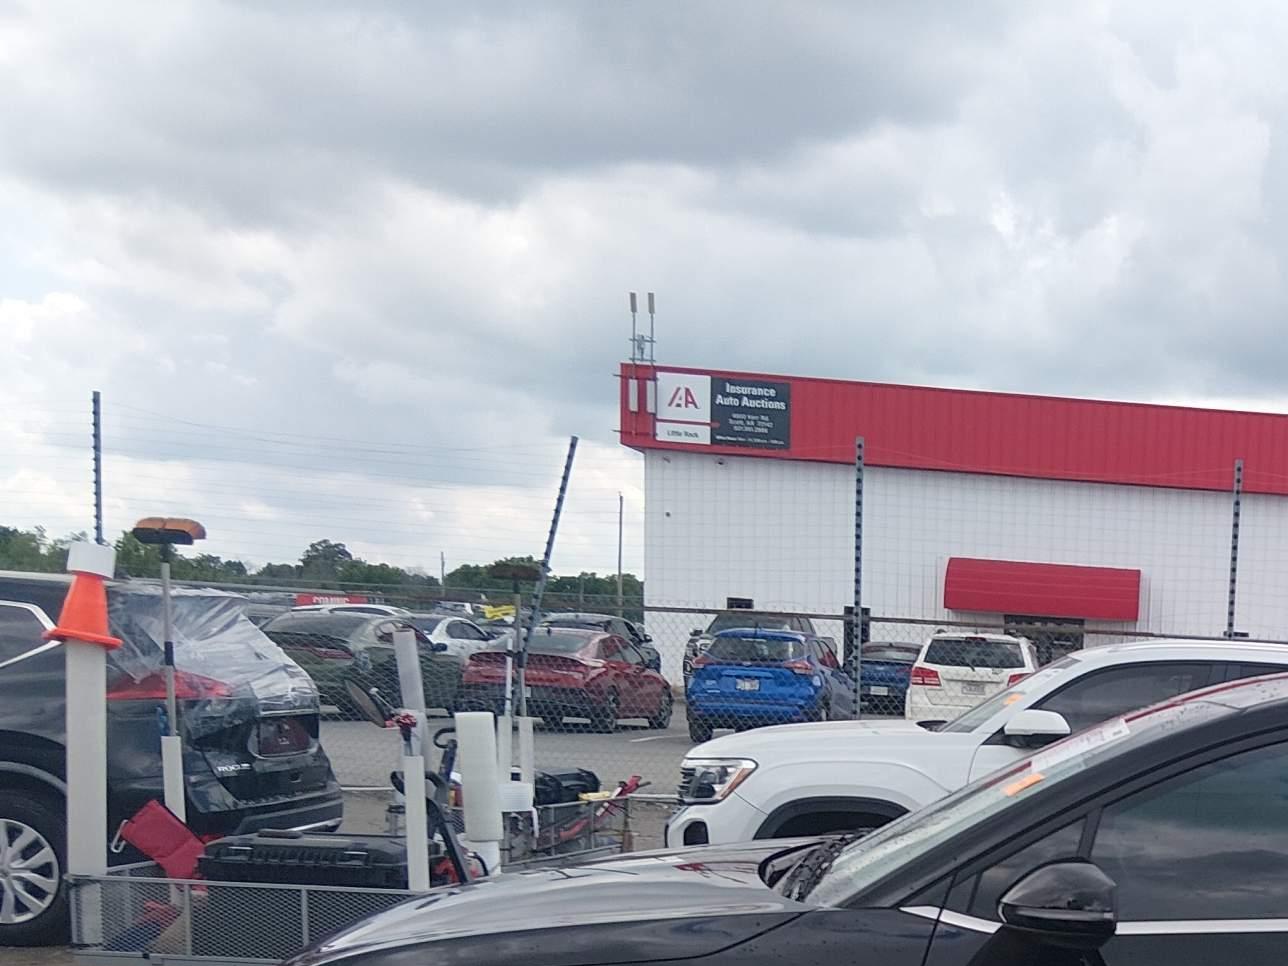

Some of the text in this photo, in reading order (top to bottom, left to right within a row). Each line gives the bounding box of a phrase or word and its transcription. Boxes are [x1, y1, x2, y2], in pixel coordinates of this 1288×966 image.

[726, 382, 776, 397] Insurance
[715, 394, 786, 410] Auto Auctions
